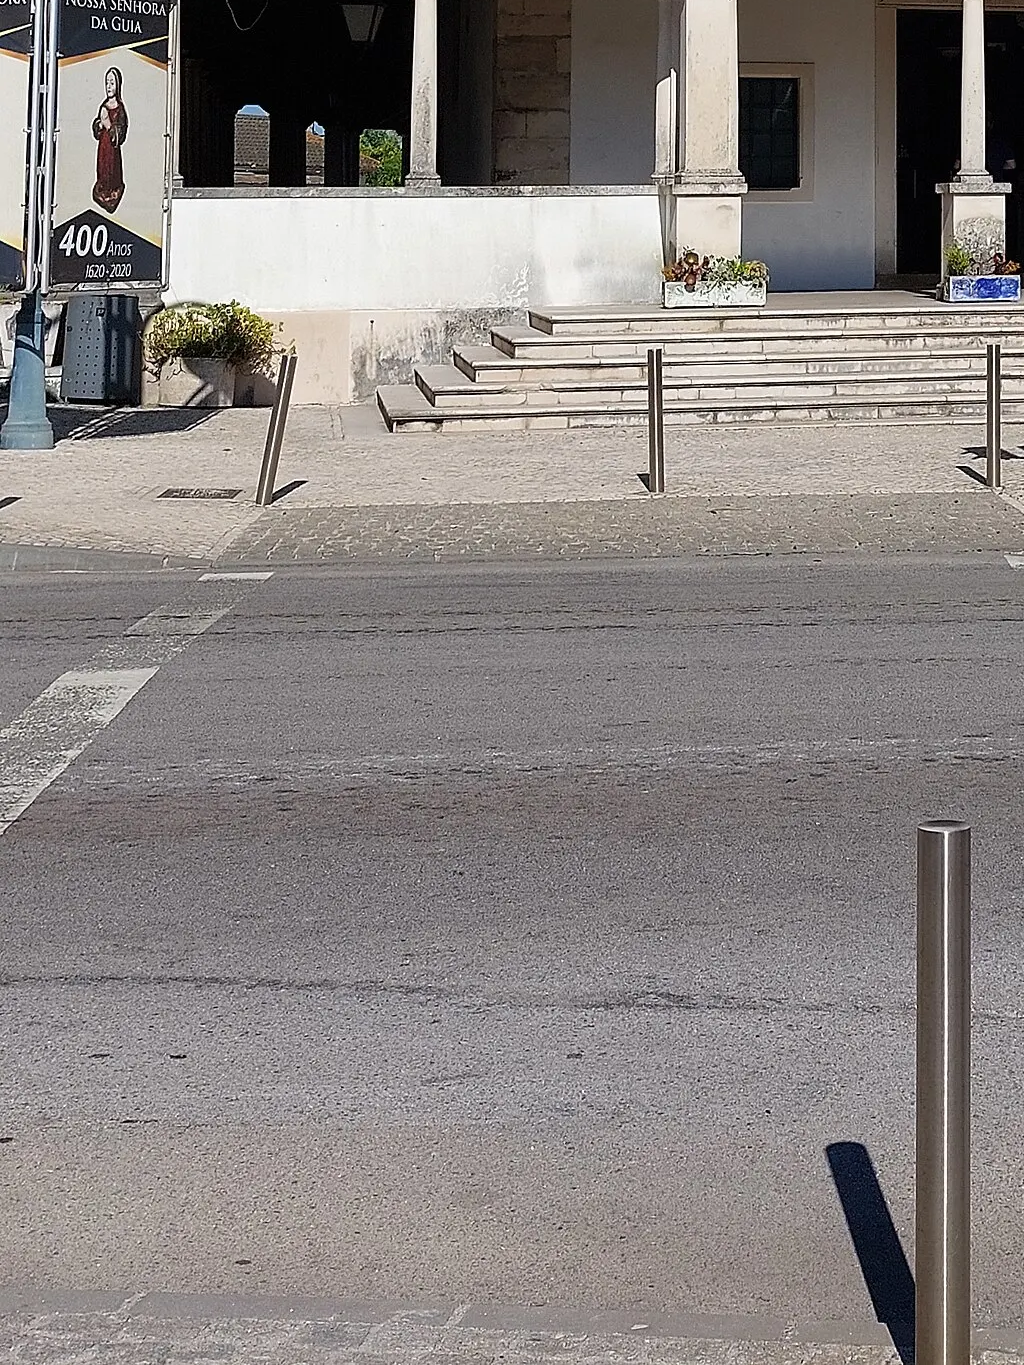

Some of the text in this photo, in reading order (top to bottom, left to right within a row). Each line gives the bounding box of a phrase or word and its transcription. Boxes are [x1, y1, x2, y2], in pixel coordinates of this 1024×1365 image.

[91, 15, 142, 34] DA GUIA
[59, 224, 133, 257] 400 Anos
